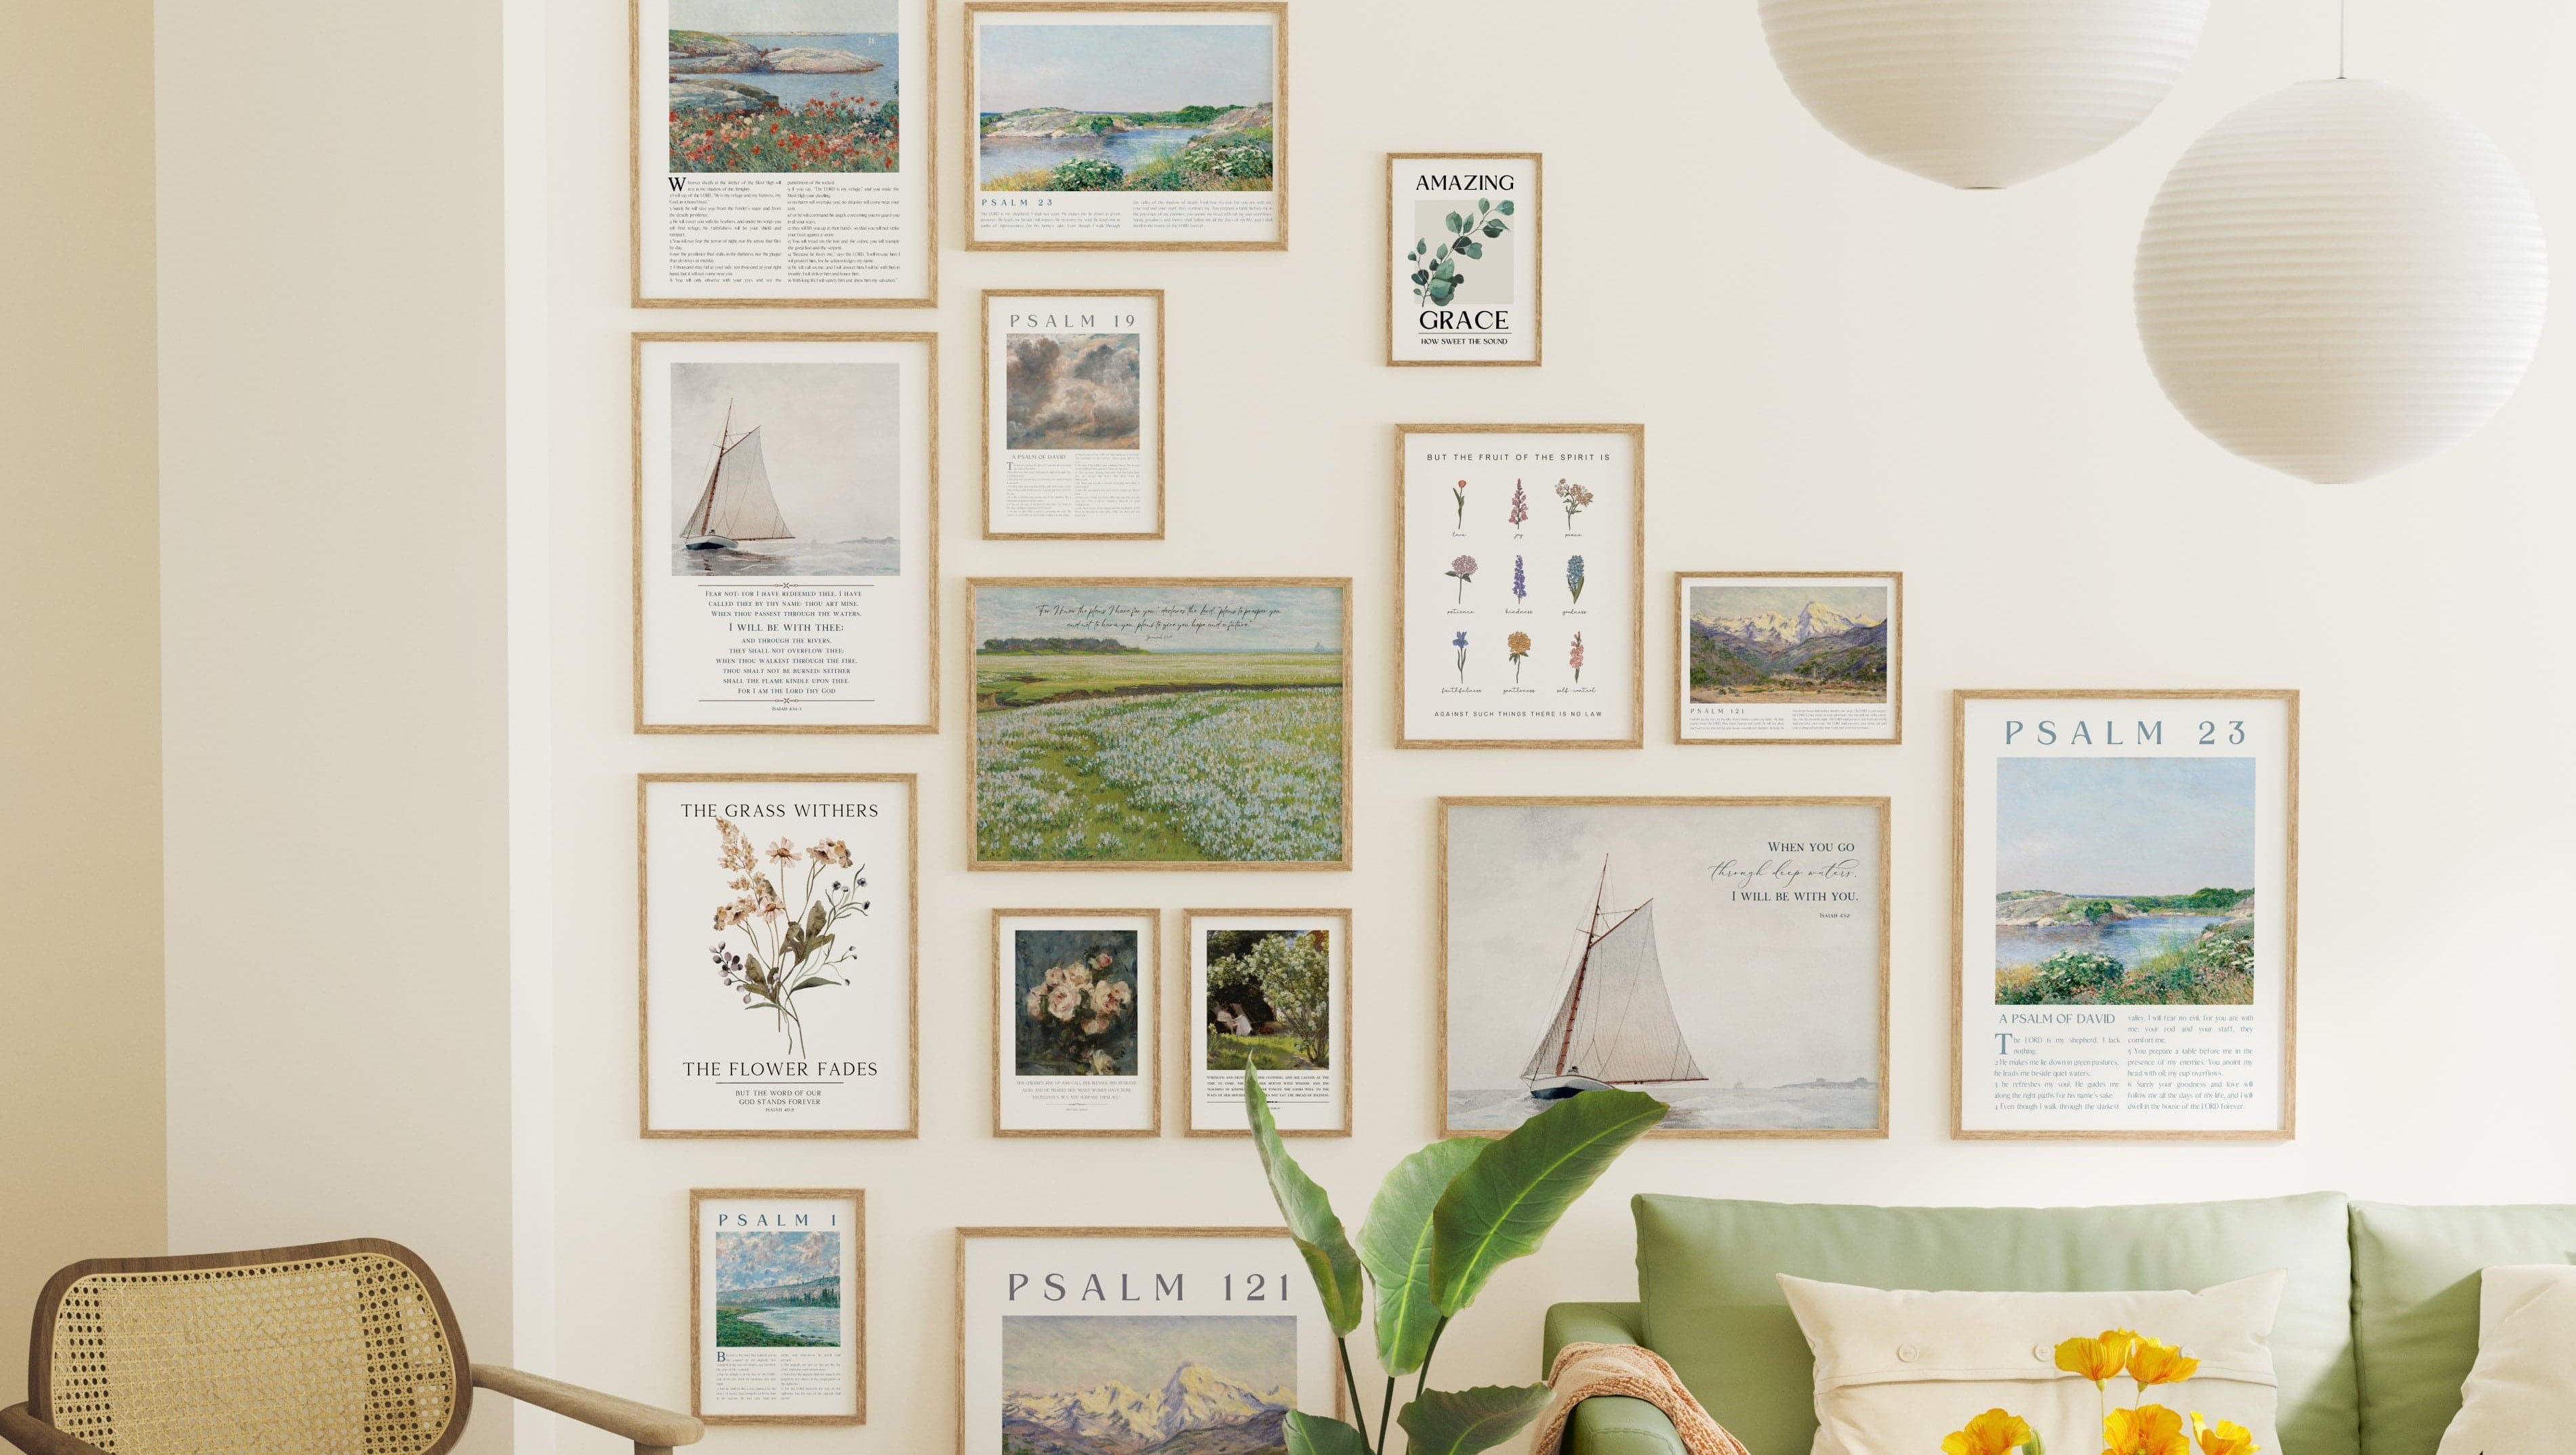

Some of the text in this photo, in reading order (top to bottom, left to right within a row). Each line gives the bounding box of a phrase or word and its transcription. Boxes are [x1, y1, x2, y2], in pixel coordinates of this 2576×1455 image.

[1416, 175, 1514, 190] AMAZING
[1011, 314, 1134, 327] PSALM 19
[1420, 311, 1508, 329] GRACE
[1441, 686, 1482, 695] faithfulness
[1556, 686, 1596, 695] self-control
[2007, 721, 2245, 745] PSALM 23
[681, 804, 879, 817] THE GRASS WITHERS
[1768, 842, 1854, 852] WHEN YOU GO
[1707, 859, 1773, 888] through
[1772, 859, 1803, 888] deep
[1732, 892, 1858, 901] I WILL BE WITH YOU.
[1999, 1014, 2115, 1024] A PSALM OF DAVID
[683, 1062, 877, 1076] THE FLOWER FADES
[719, 1214, 835, 1226] PSALM 1
[1009, 1273, 1287, 1301] PSALM 121
